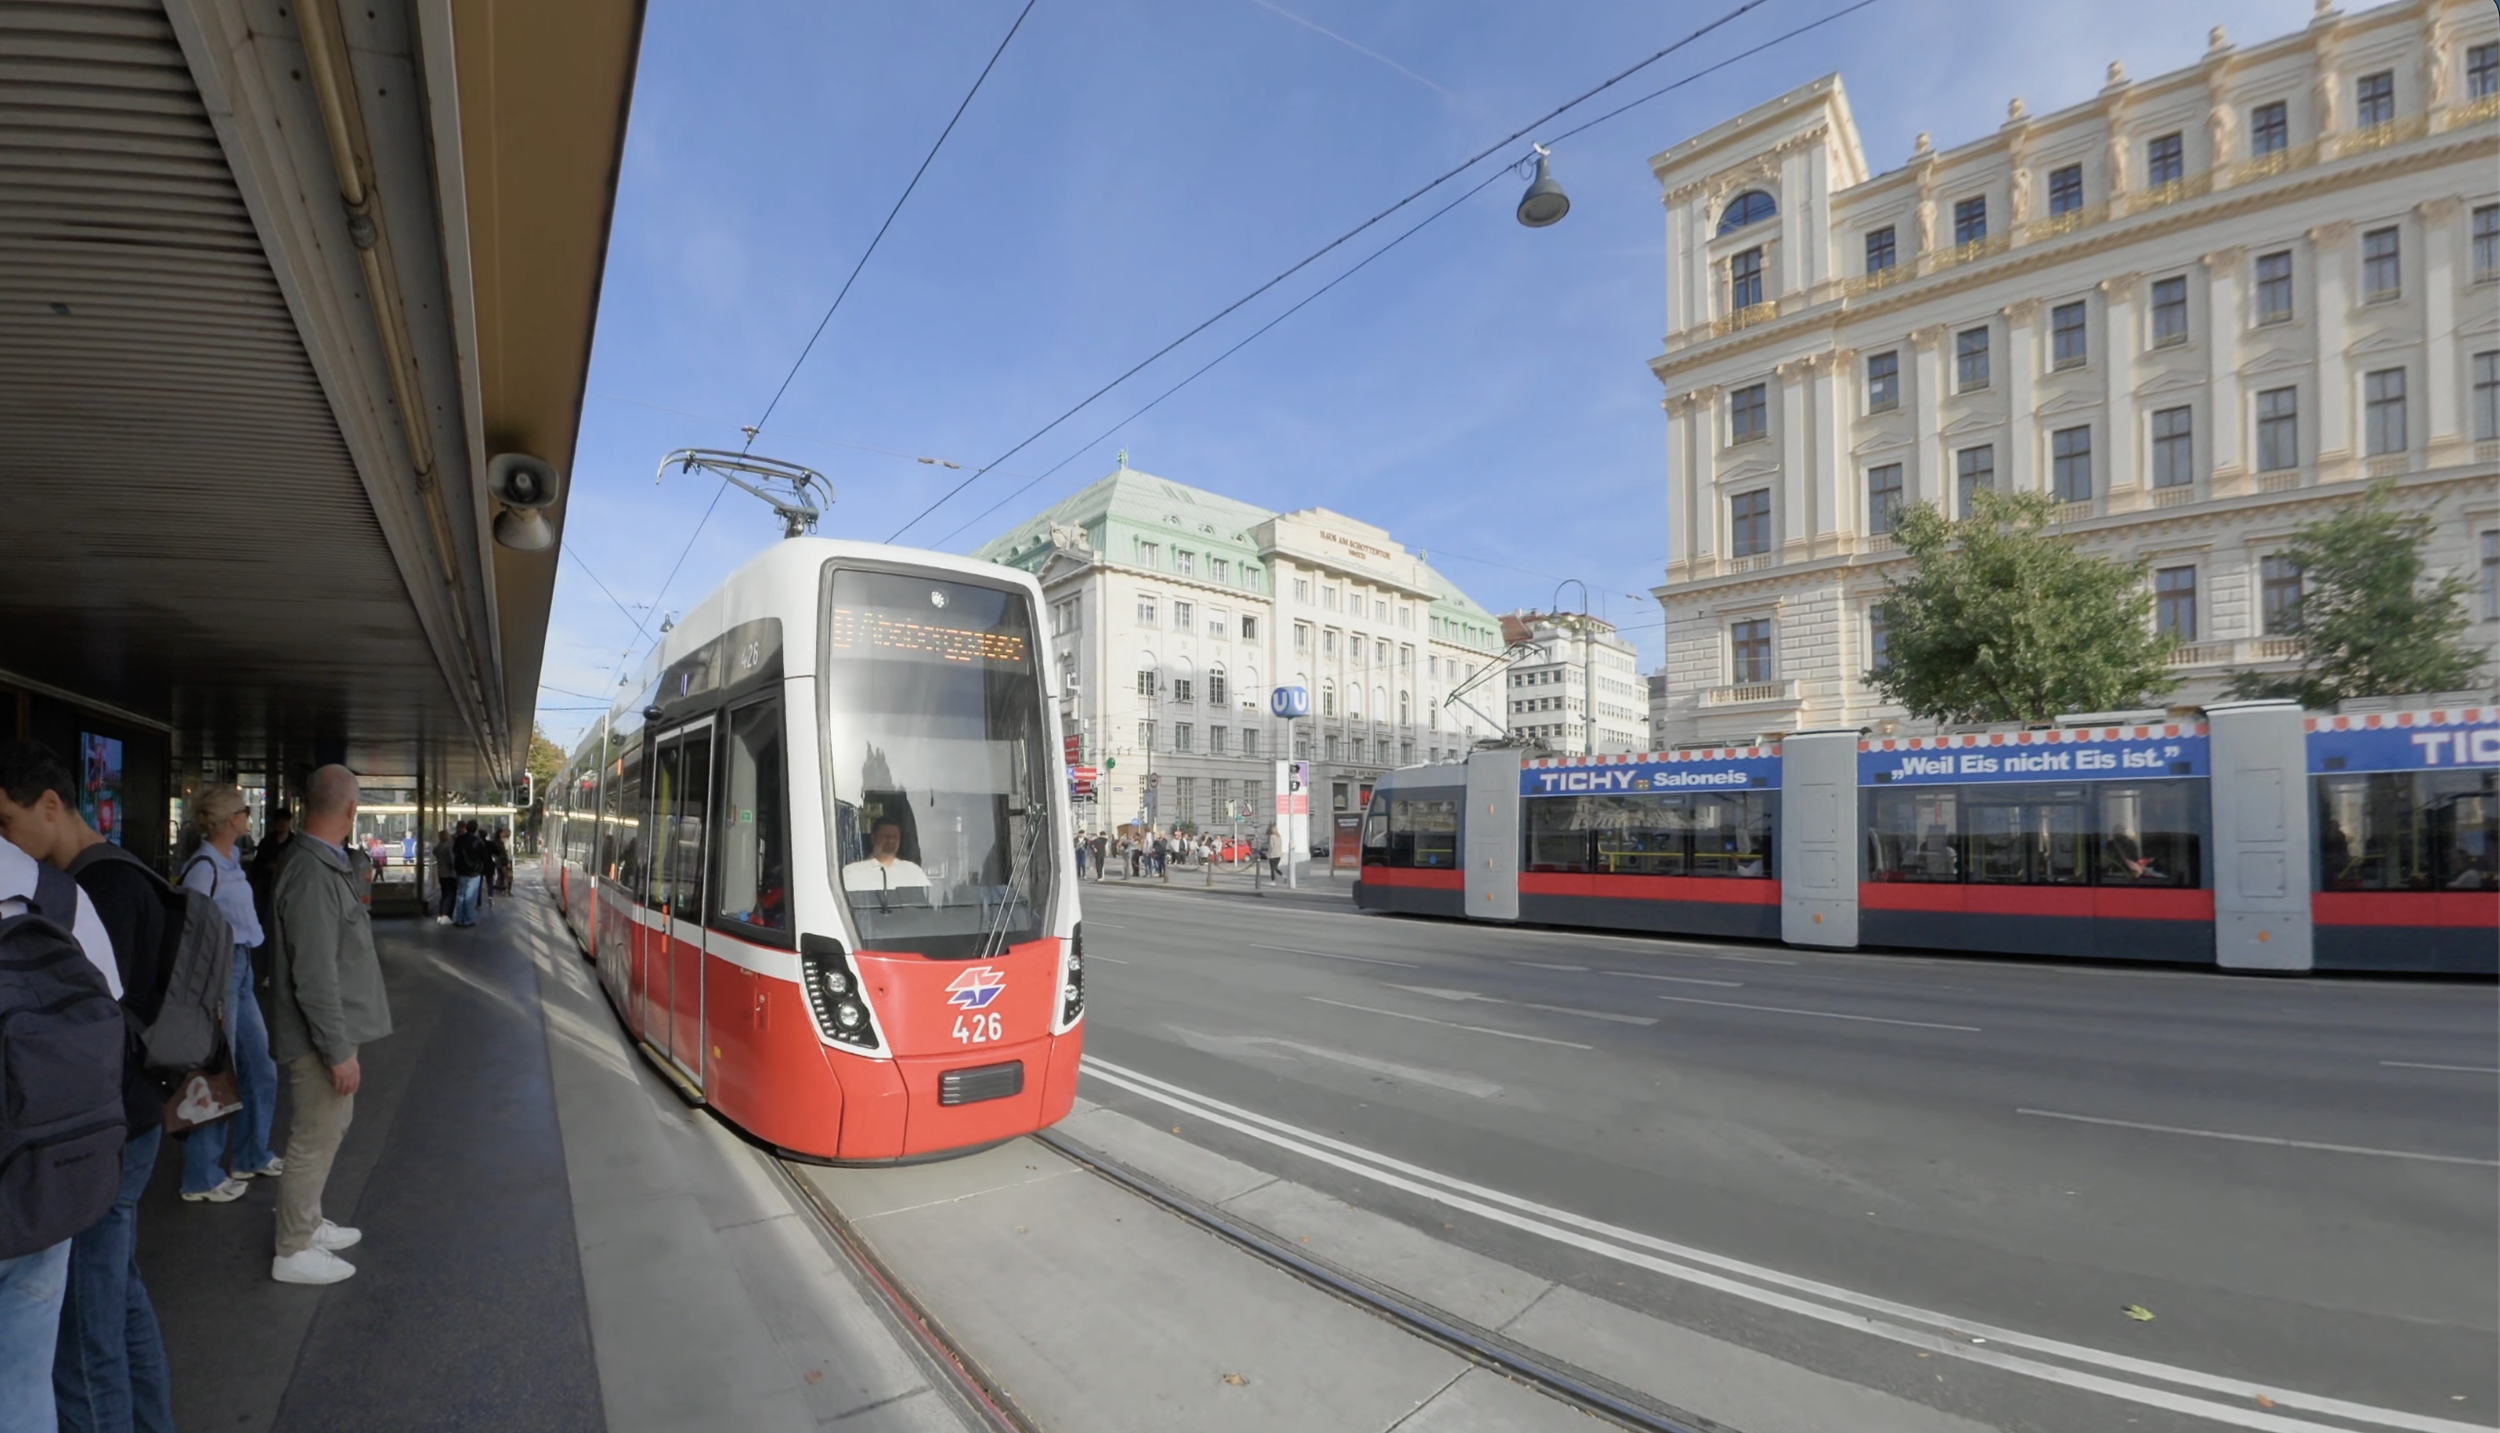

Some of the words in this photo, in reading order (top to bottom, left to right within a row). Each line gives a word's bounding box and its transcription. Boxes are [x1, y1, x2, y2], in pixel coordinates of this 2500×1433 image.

[834, 609, 854, 648] D
[741, 641, 759, 670] 426
[1273, 691, 1287, 712] U
[1293, 691, 1307, 712] U
[1960, 755, 1999, 774] Eis
[2004, 750, 2071, 773] nicht
[2075, 748, 2117, 770] Eis
[1539, 769, 1637, 791] TICHY
[1653, 769, 1748, 787] Saloneis
[952, 1012, 1002, 1045] 426
